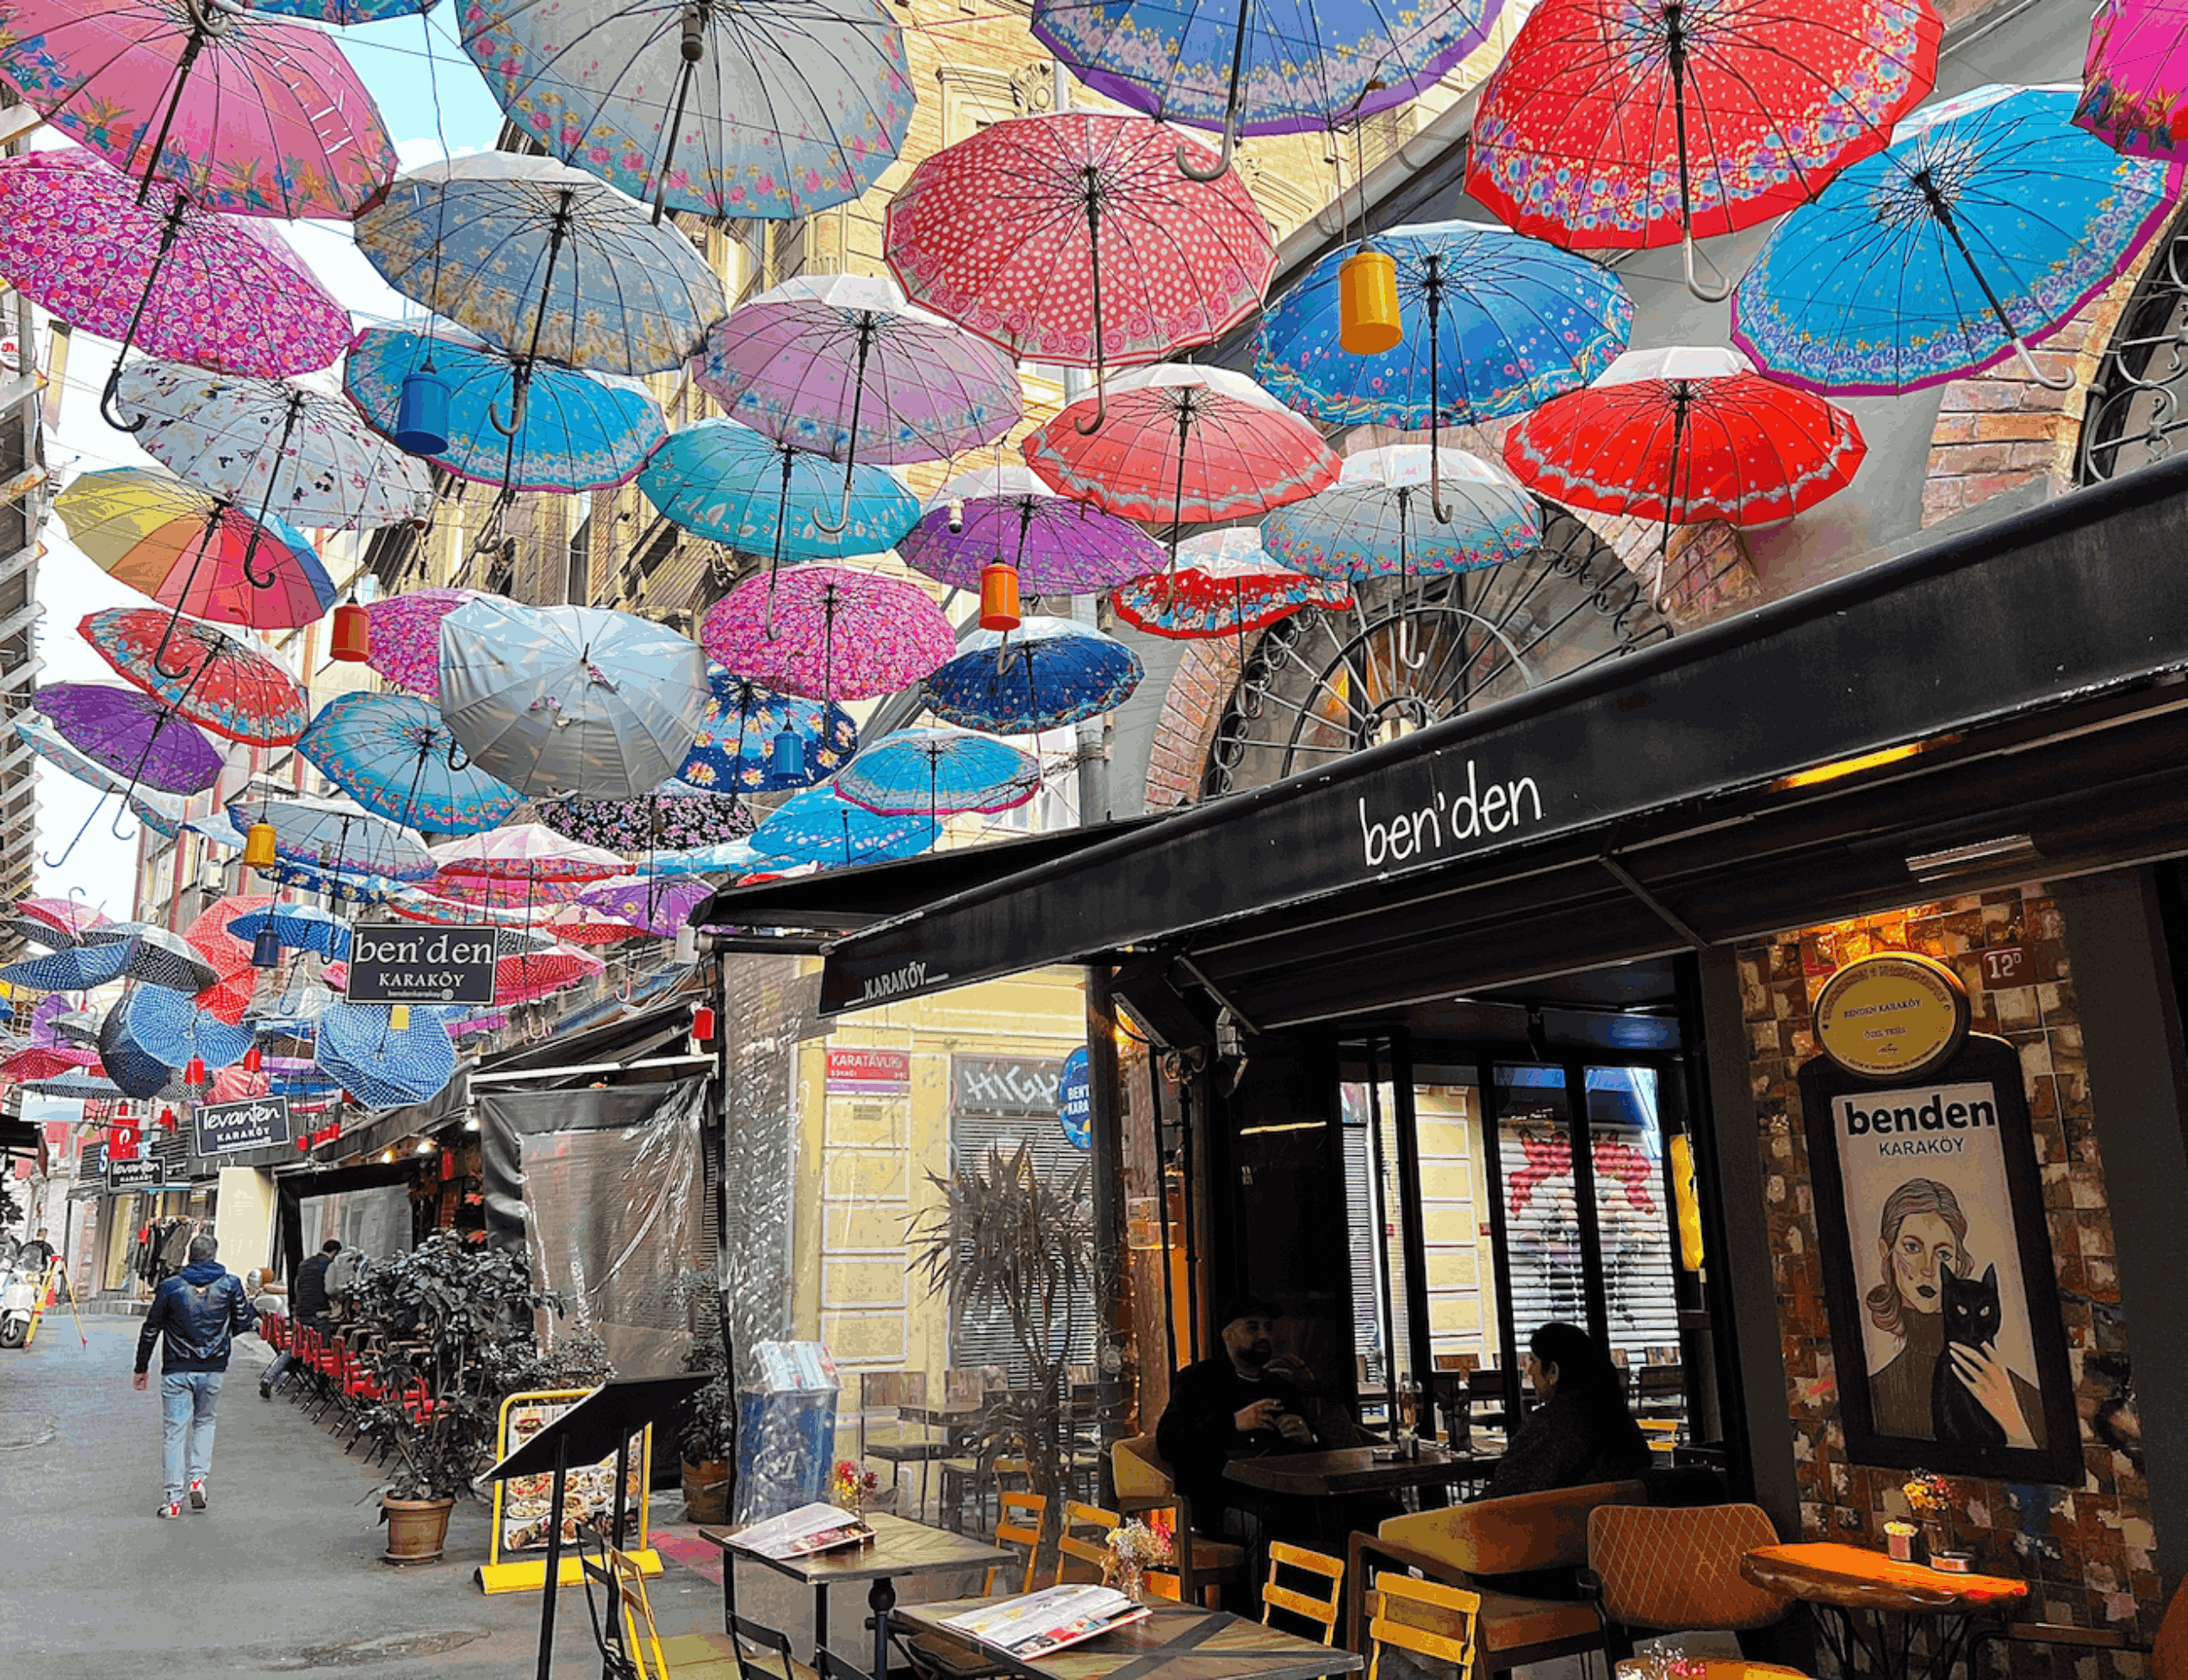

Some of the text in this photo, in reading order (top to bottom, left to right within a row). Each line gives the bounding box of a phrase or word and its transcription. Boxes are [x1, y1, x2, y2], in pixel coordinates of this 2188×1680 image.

[1358, 759, 1543, 866] ben'den
[354, 932, 493, 964] ben'den
[379, 970, 465, 987] KARAKÖY
[864, 961, 926, 1001] KARAKÖY
[1843, 1093, 1996, 1136] benden
[1879, 1136, 1965, 1157] KARAKÖY
